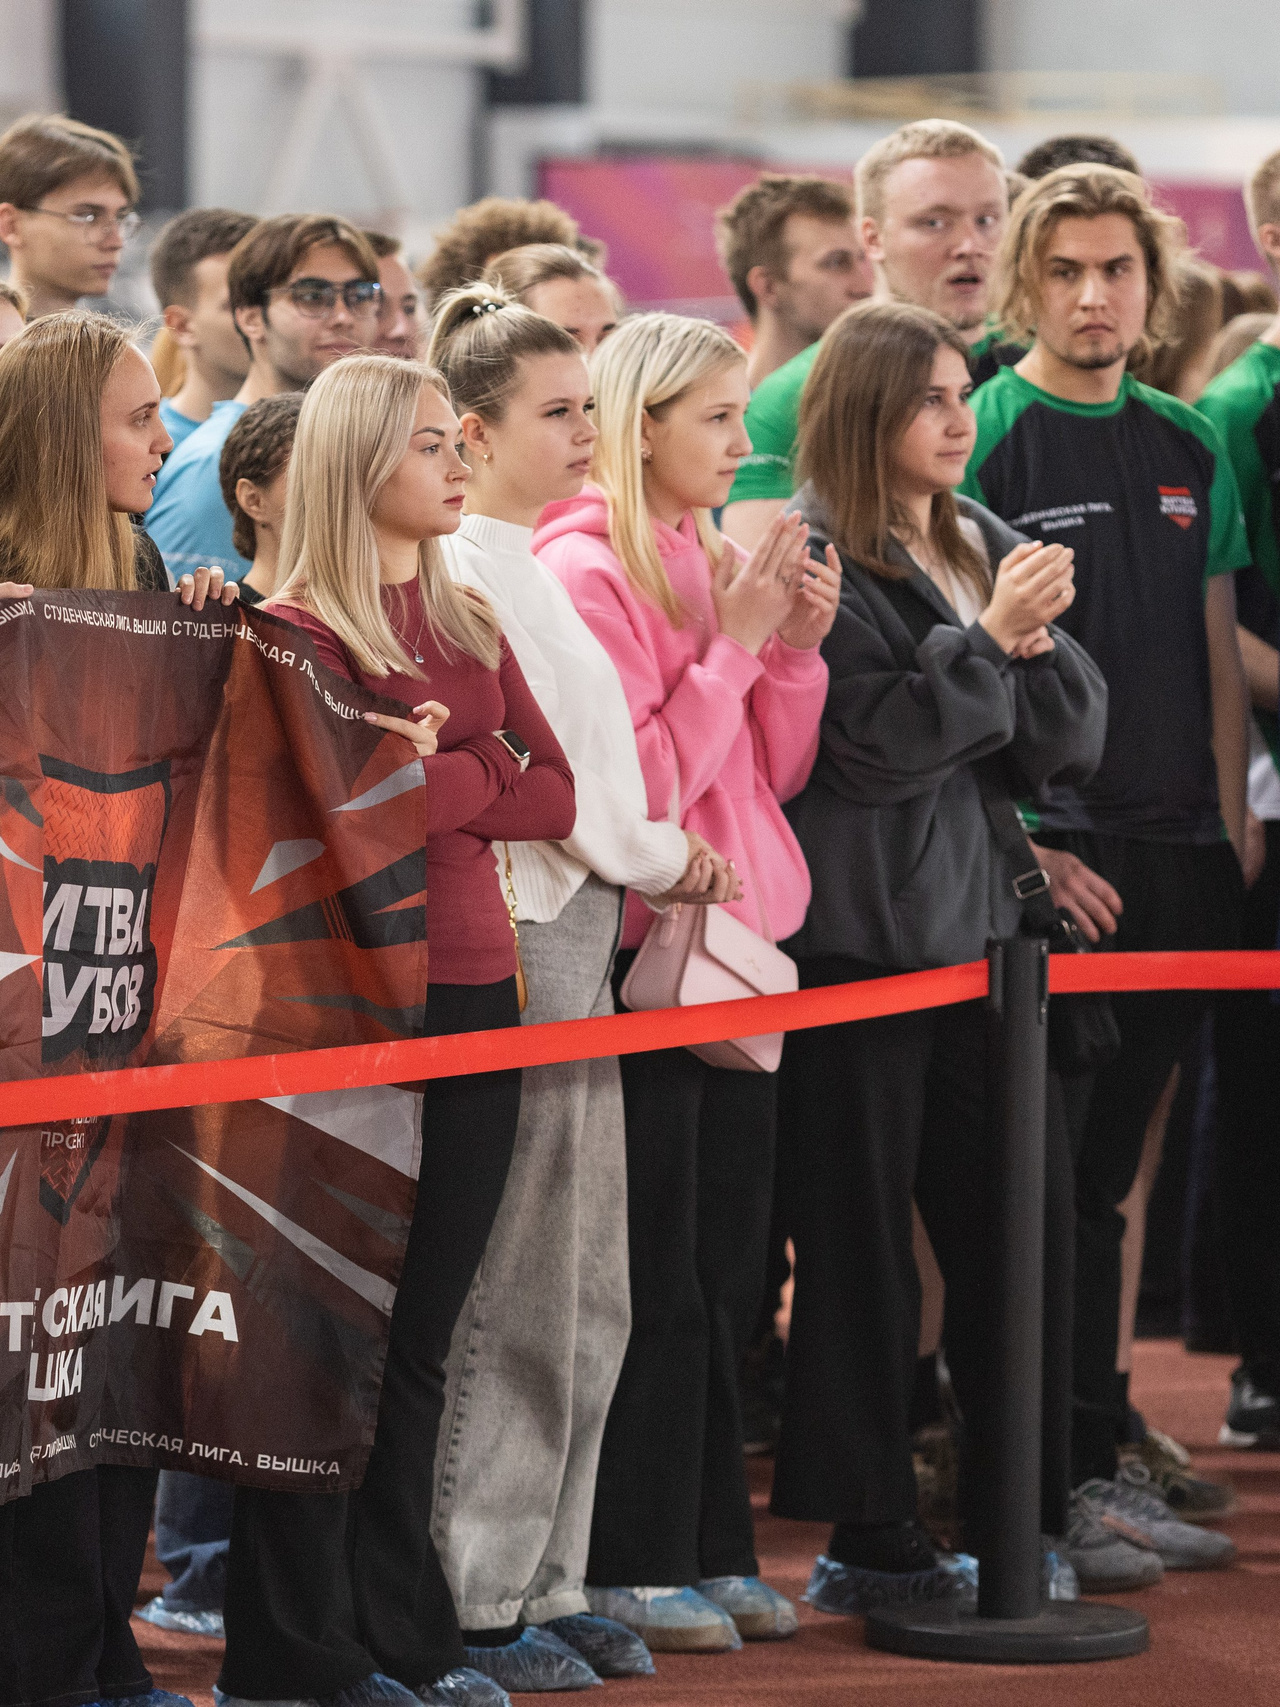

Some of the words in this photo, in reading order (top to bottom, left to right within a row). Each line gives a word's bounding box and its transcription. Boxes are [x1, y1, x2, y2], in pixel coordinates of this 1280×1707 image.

[44, 603, 115, 629] СТУДЕНЧЕСКАЯ
[133, 618, 167, 635] ВЫШКА
[172, 620, 296, 667] СТУДЕНЧЕСКАЯ
[43, 881, 148, 956] ИТВА
[42, 961, 145, 1038] УБОВ
[108, 1275, 239, 1342] ИГА
[27, 1347, 83, 1401] ШКА
[189, 1442, 249, 1466] ЛИГА.
[257, 1454, 340, 1475] ВЫШКА
